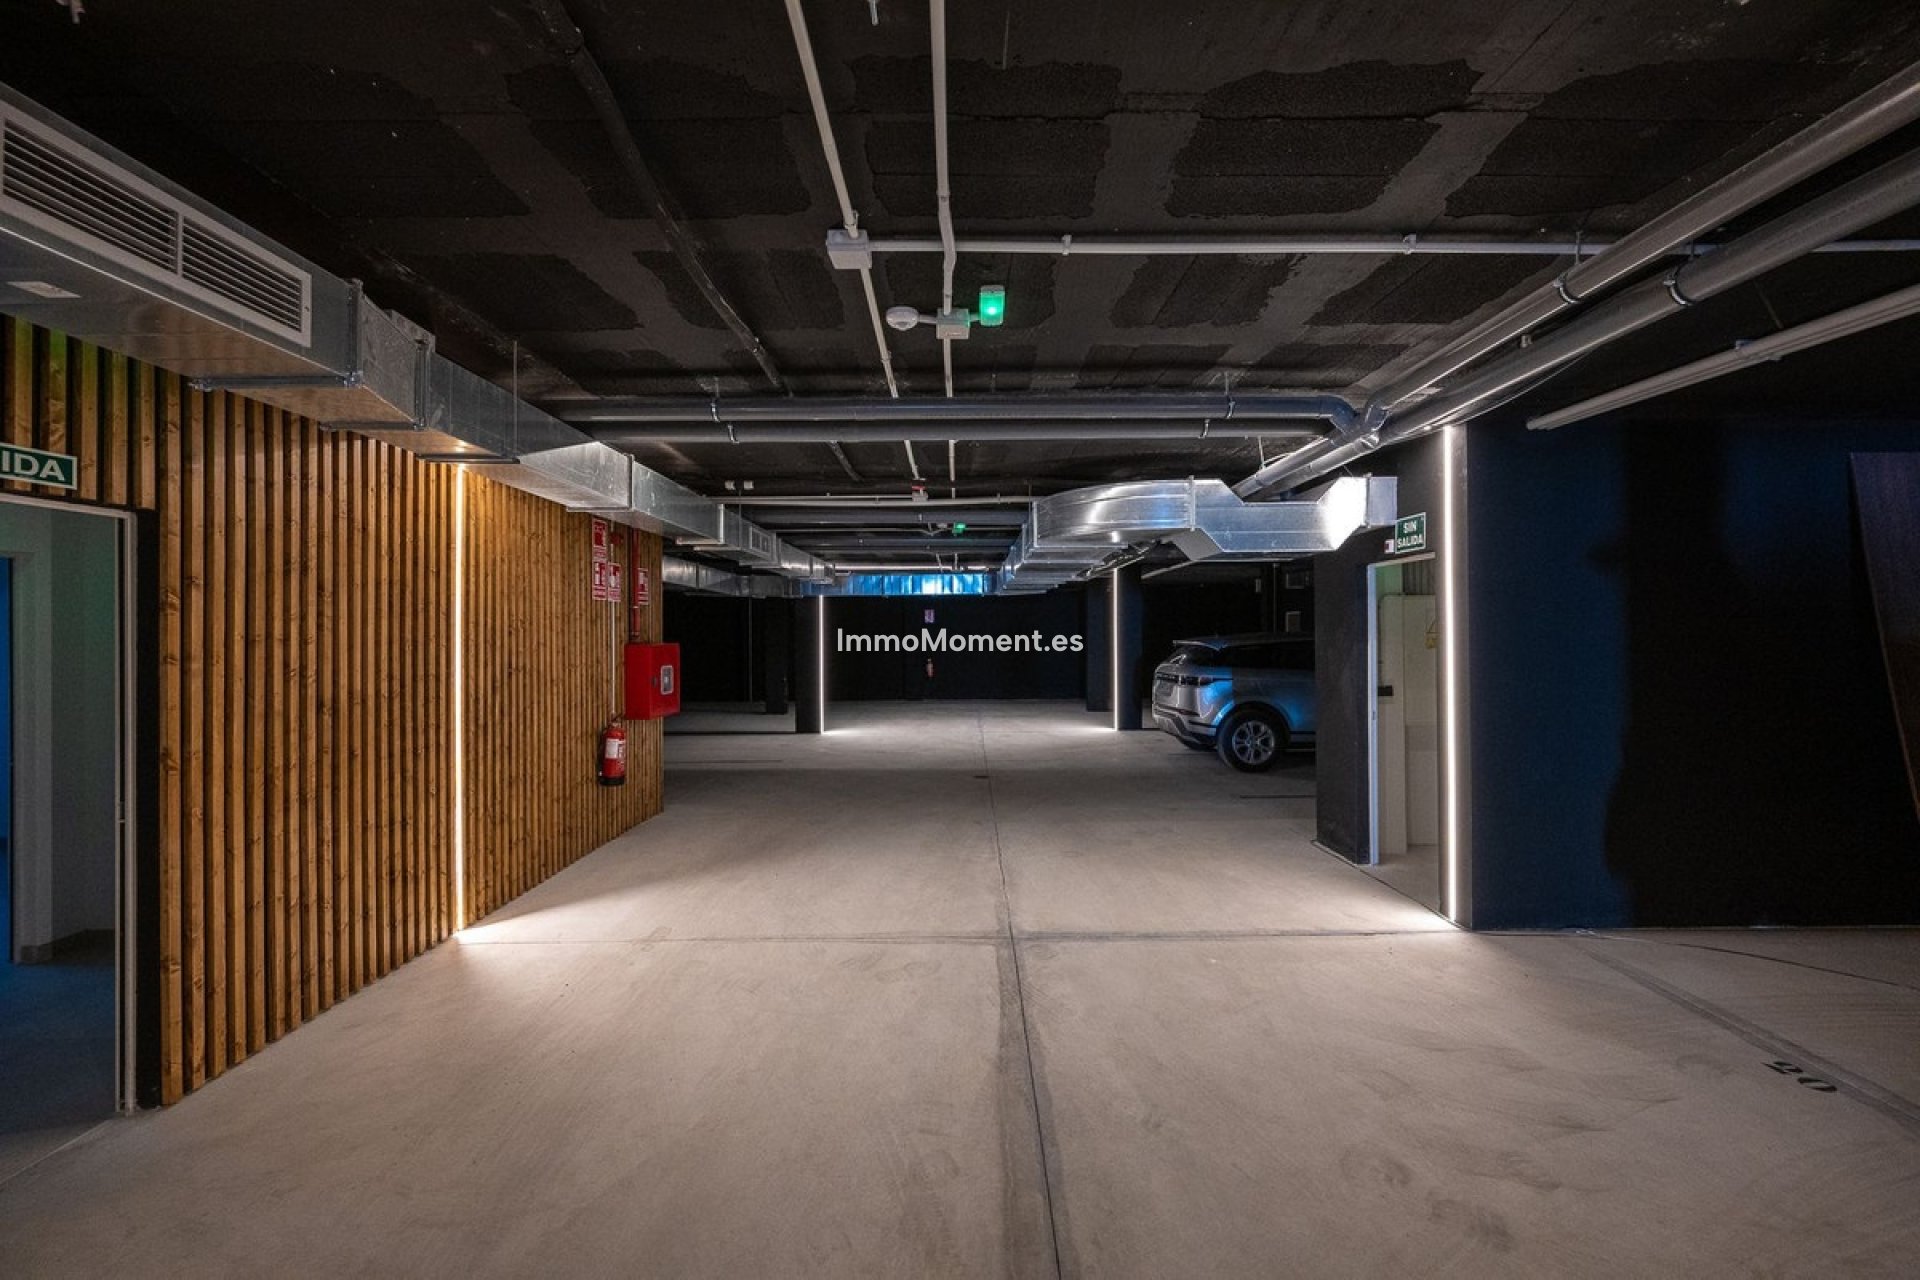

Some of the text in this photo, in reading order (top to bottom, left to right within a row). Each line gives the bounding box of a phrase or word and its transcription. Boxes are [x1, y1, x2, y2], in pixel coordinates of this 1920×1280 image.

[2, 450, 65, 481] IDA
[1403, 520, 1417, 534] SIN
[1397, 534, 1424, 548] SALIDA
